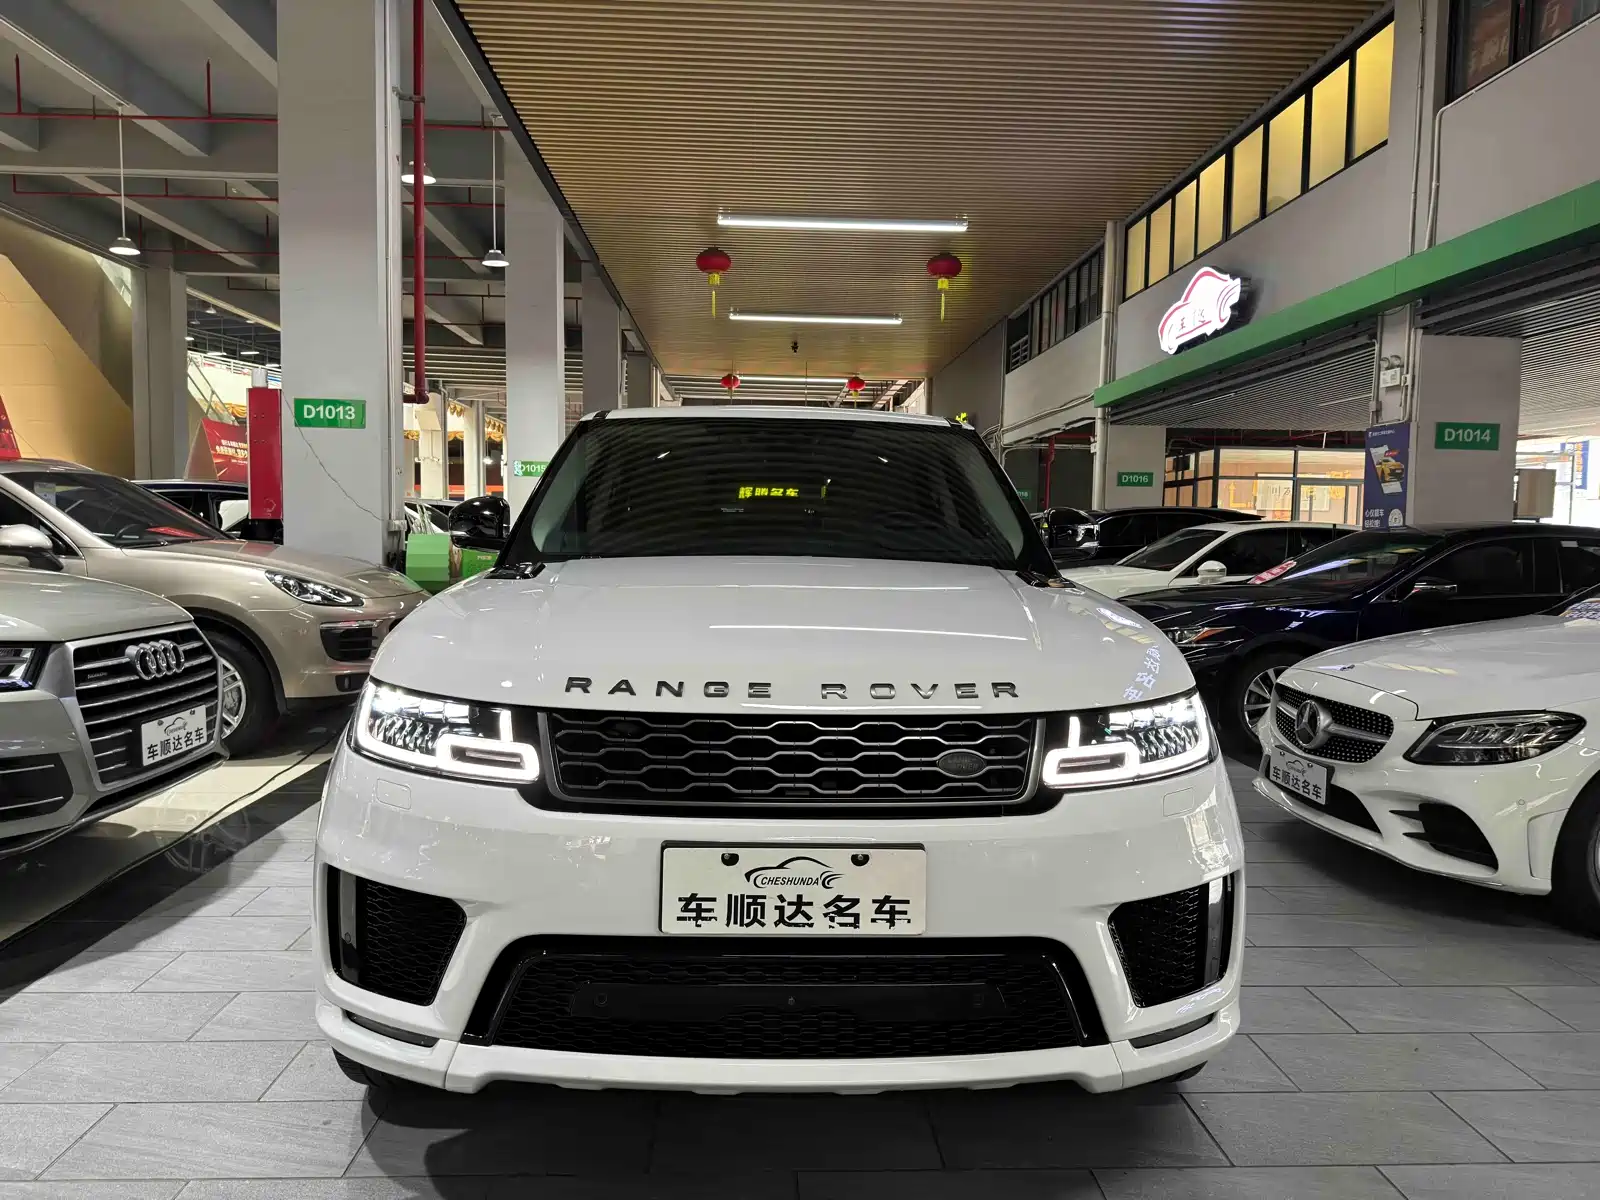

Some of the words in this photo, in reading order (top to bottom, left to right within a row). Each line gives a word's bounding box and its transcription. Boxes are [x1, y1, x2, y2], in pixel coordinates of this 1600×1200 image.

[303, 404, 356, 420] D1013
[1443, 428, 1491, 442] D1014
[1121, 474, 1149, 483] D1016
[564, 676, 772, 699] RANGE
[820, 681, 1019, 700] ROVER
[146, 727, 205, 761] 车顺达名车
[1272, 765, 1322, 800] 车顺达名车
[760, 875, 820, 887] CHESHUNDA
[675, 892, 912, 931] 车顺达名车
